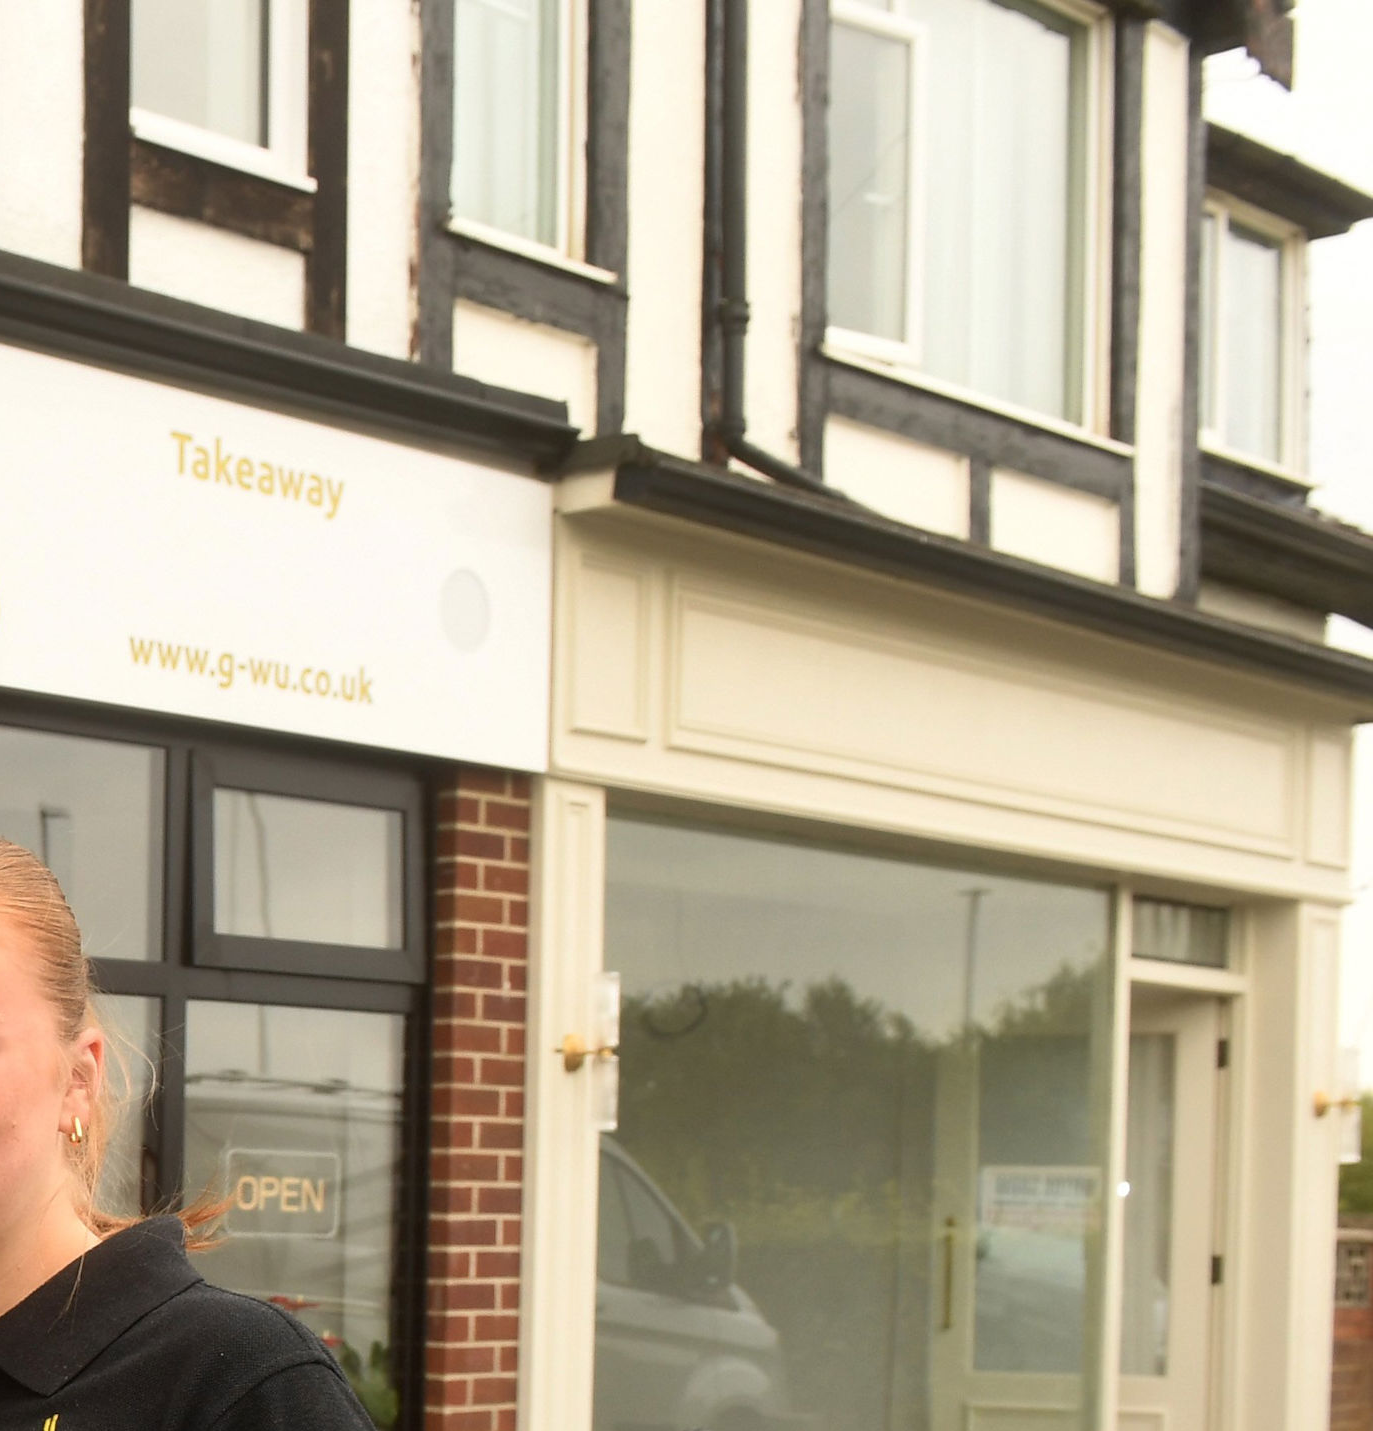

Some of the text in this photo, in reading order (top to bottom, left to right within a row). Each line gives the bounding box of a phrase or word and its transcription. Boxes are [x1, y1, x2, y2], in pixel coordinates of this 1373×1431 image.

[170, 430, 345, 520] Takeaway
[129, 635, 373, 704] www.g-wu.co.uk
[236, 1175, 325, 1212] OPEN
